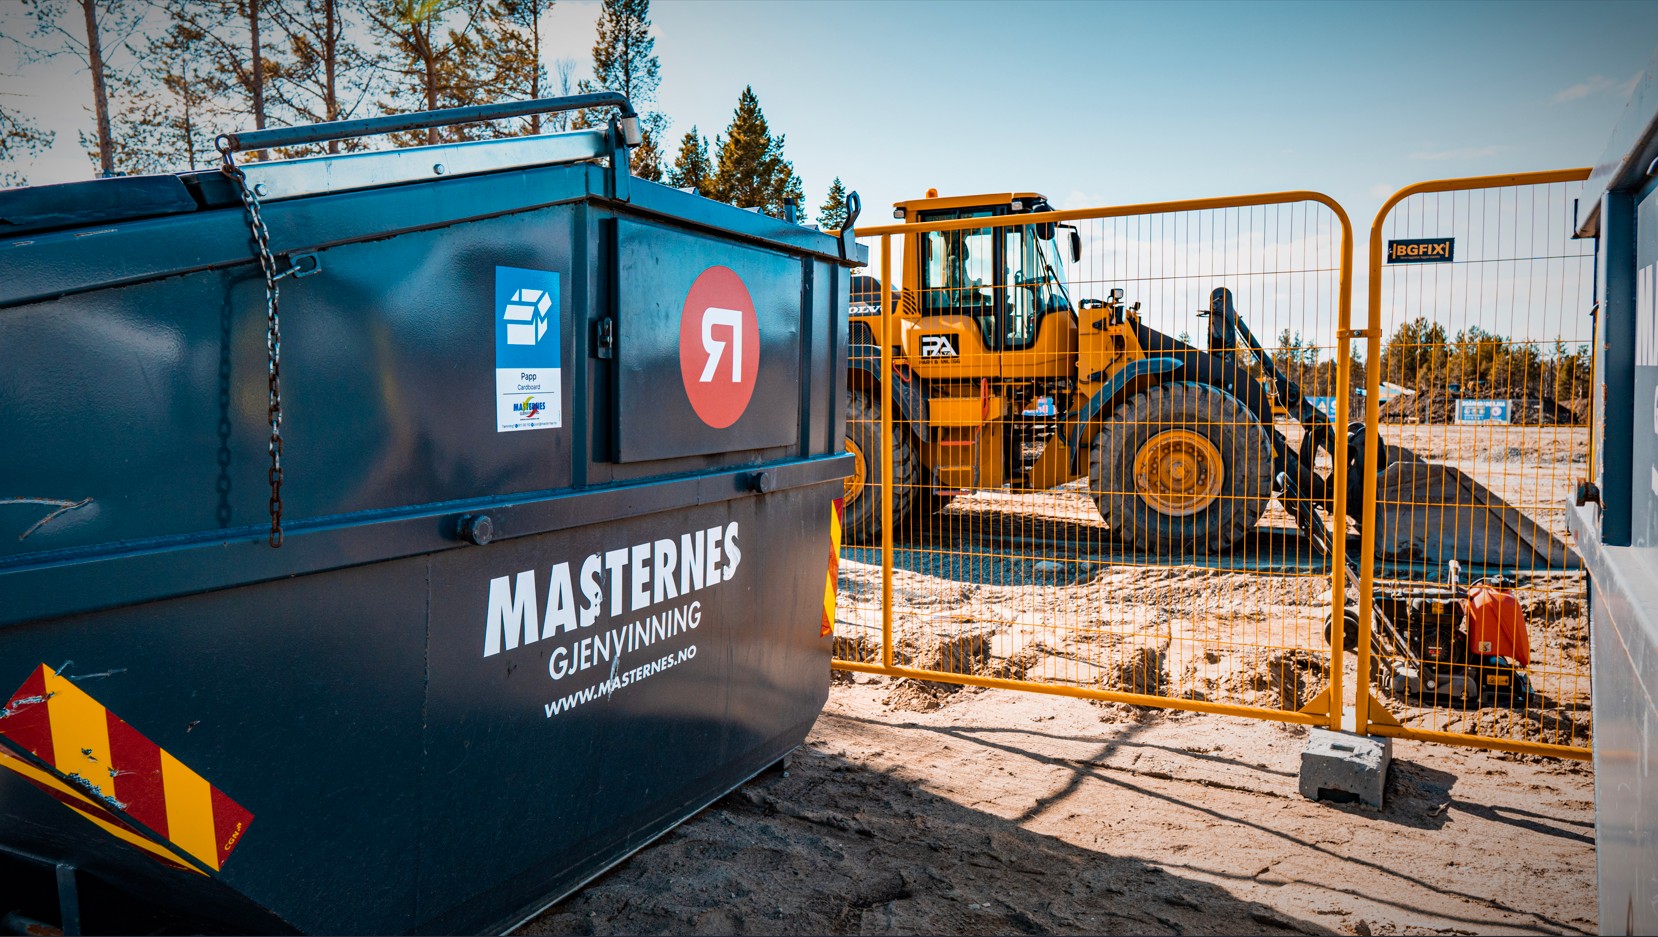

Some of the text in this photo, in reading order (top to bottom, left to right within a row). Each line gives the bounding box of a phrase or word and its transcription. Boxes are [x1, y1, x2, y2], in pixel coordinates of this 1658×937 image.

[513, 402, 545, 411] MASTERNES
[520, 372, 537, 382] Papp
[483, 521, 742, 658] MASTERNES
[549, 600, 702, 681] GJENVINNING
[543, 644, 697, 719] WWW.MASTERNES.NO
